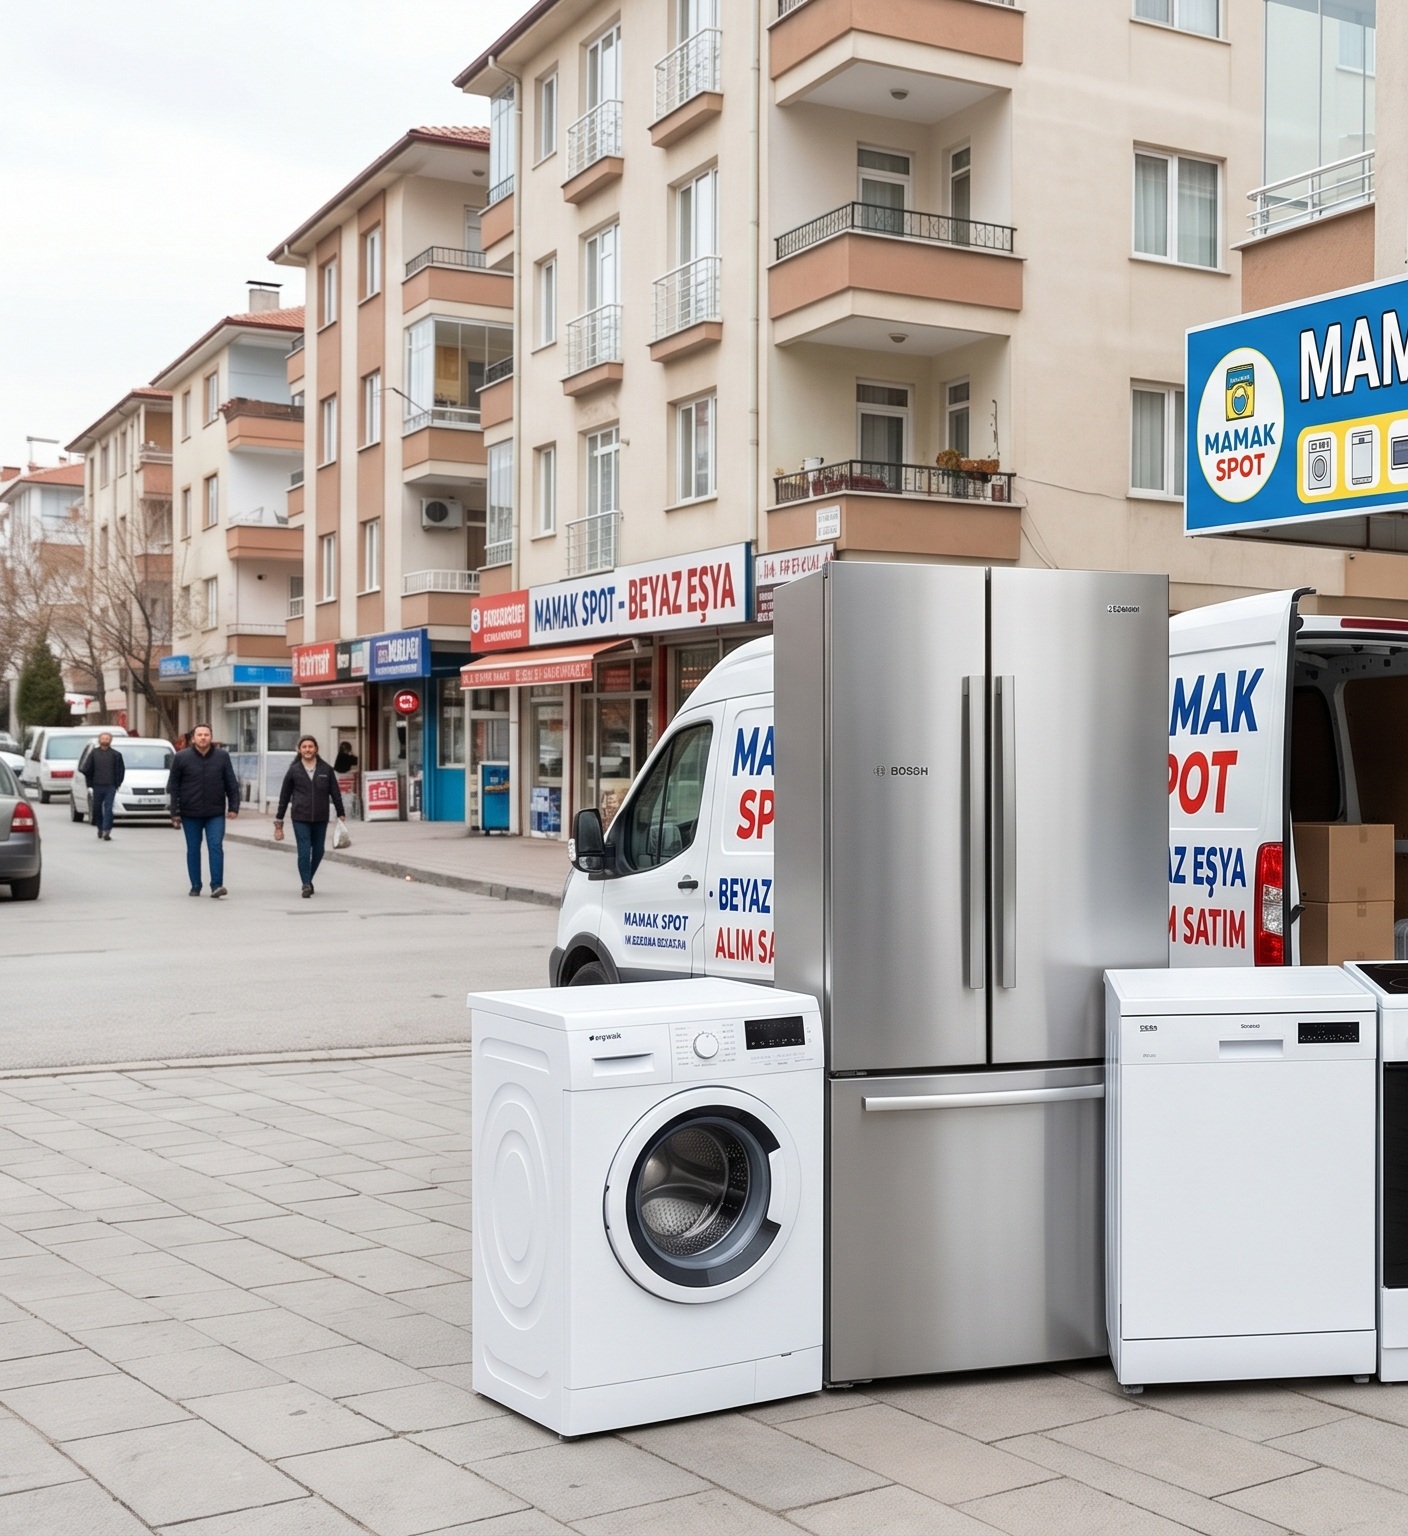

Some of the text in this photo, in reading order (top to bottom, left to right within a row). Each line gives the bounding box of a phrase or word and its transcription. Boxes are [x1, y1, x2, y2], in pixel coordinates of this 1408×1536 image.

[1205, 422, 1275, 456] MAMAK
[1216, 453, 1265, 482] SPOT
[534, 591, 579, 633] MAMAK
[582, 586, 616, 627] SPOT
[629, 570, 682, 621] BEYAZ
[687, 562, 736, 624] EŞYA
[1192, 846, 1247, 898] EŞYA
[718, 877, 773, 914] BEYAZ
[624, 912, 689, 931] MAMAK SPOT
[1183, 905, 1246, 949] SATIM
[715, 926, 754, 962] ALIM
